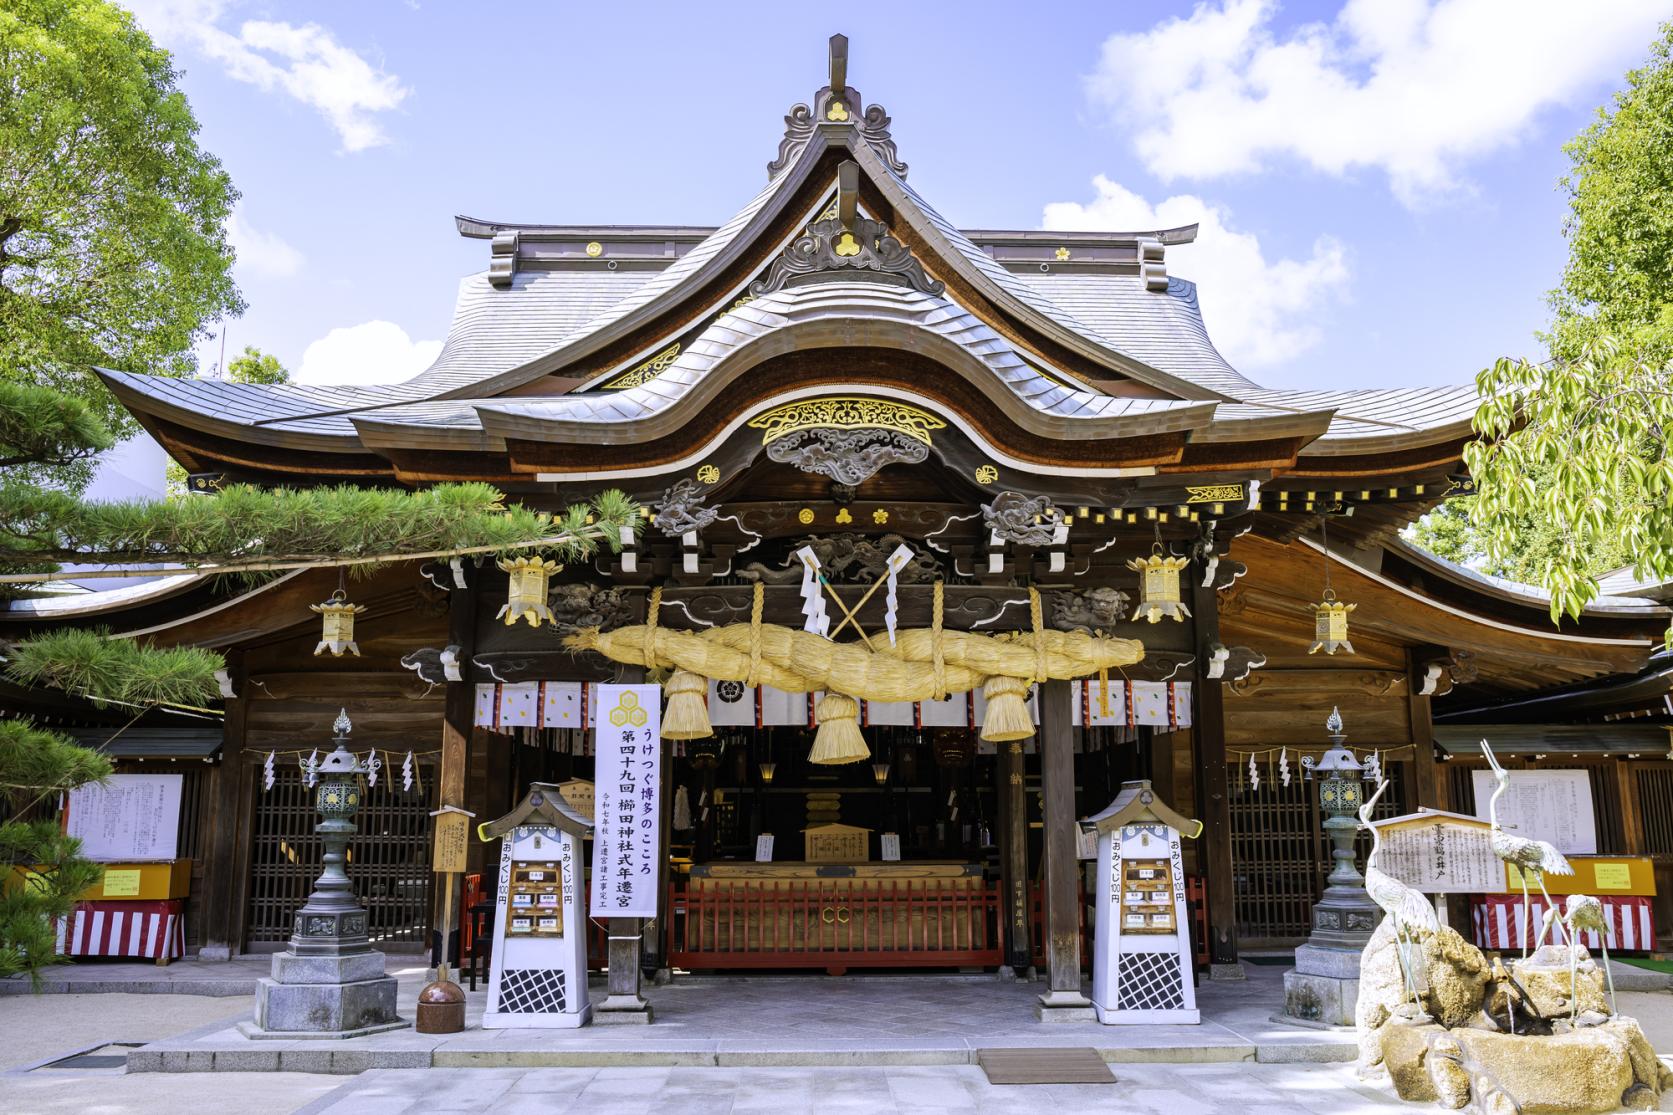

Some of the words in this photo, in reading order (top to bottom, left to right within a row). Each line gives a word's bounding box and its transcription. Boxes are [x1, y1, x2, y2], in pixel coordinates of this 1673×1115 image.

[640, 728, 655, 875] うけつぐ博多のこころ
